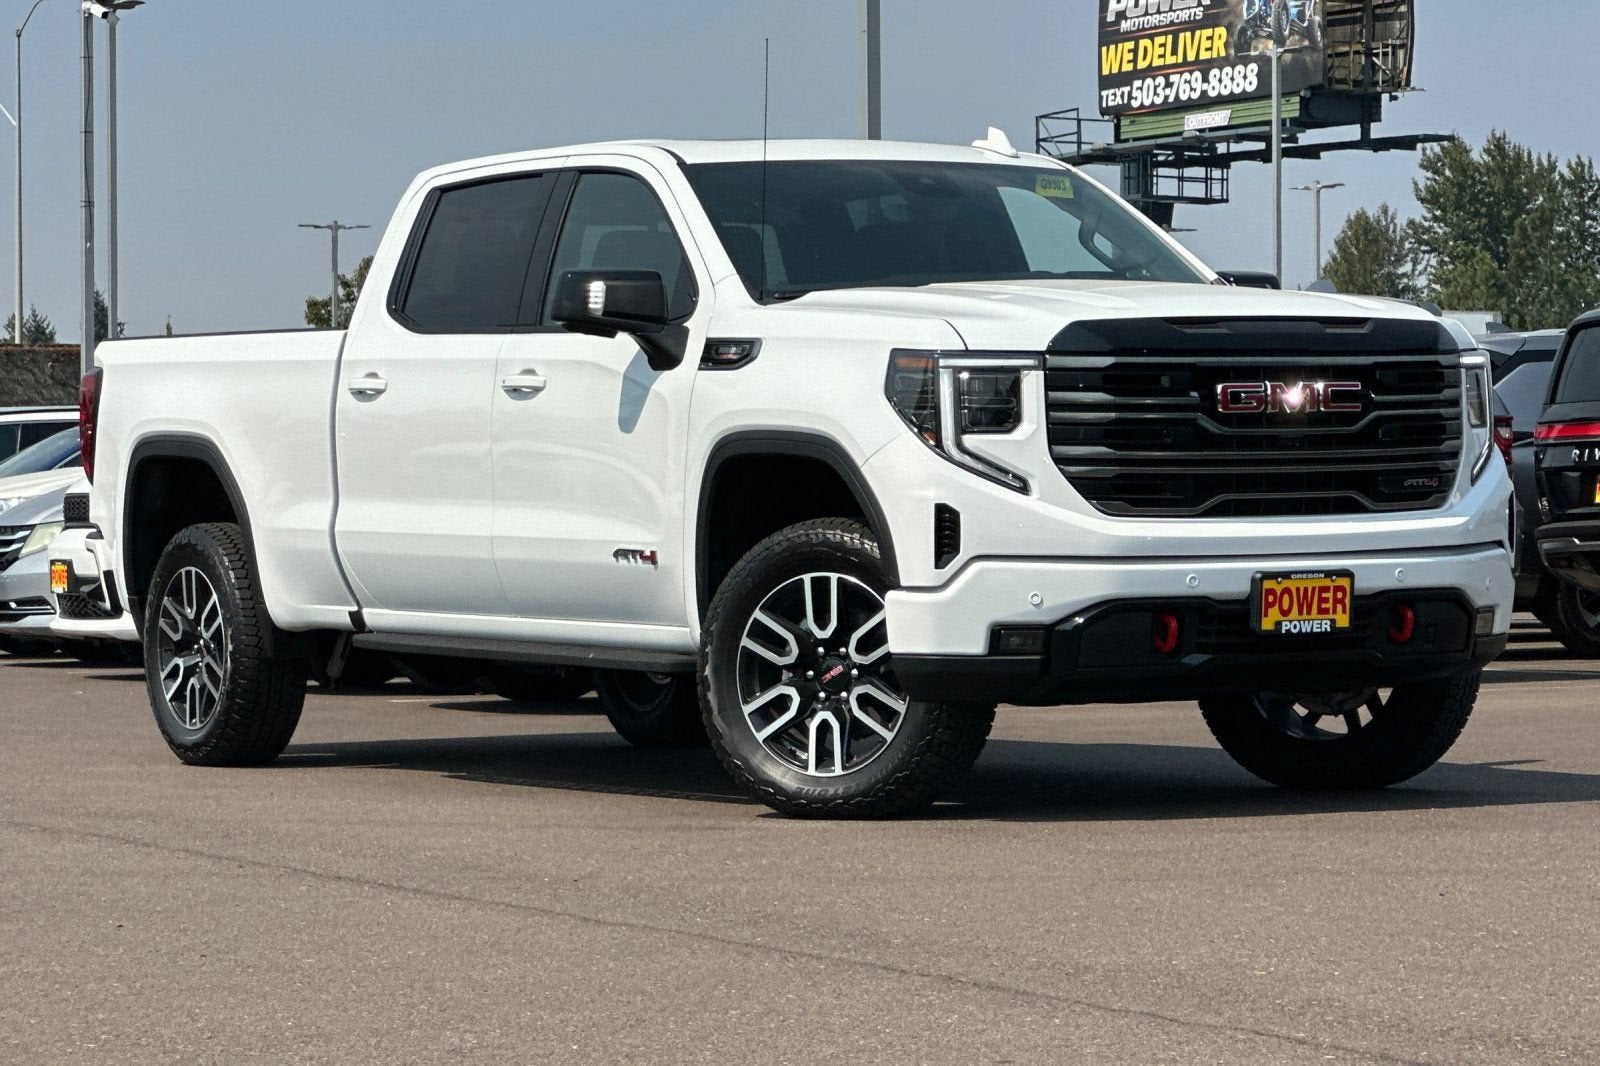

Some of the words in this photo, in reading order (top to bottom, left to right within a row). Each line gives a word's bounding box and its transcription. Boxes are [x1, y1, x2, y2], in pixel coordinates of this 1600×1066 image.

[1120, 6, 1204, 33] MOTORSPORTS
[1101, 41, 1135, 76] WE
[1137, 26, 1228, 70] DELIVER
[1101, 86, 1131, 108] TEXT
[1130, 62, 1259, 108] 503-769-8888
[1216, 381, 1362, 413] GMC
[612, 548, 659, 568] AT4
[1263, 585, 1348, 618] POWER
[1281, 619, 1331, 634] POWER
